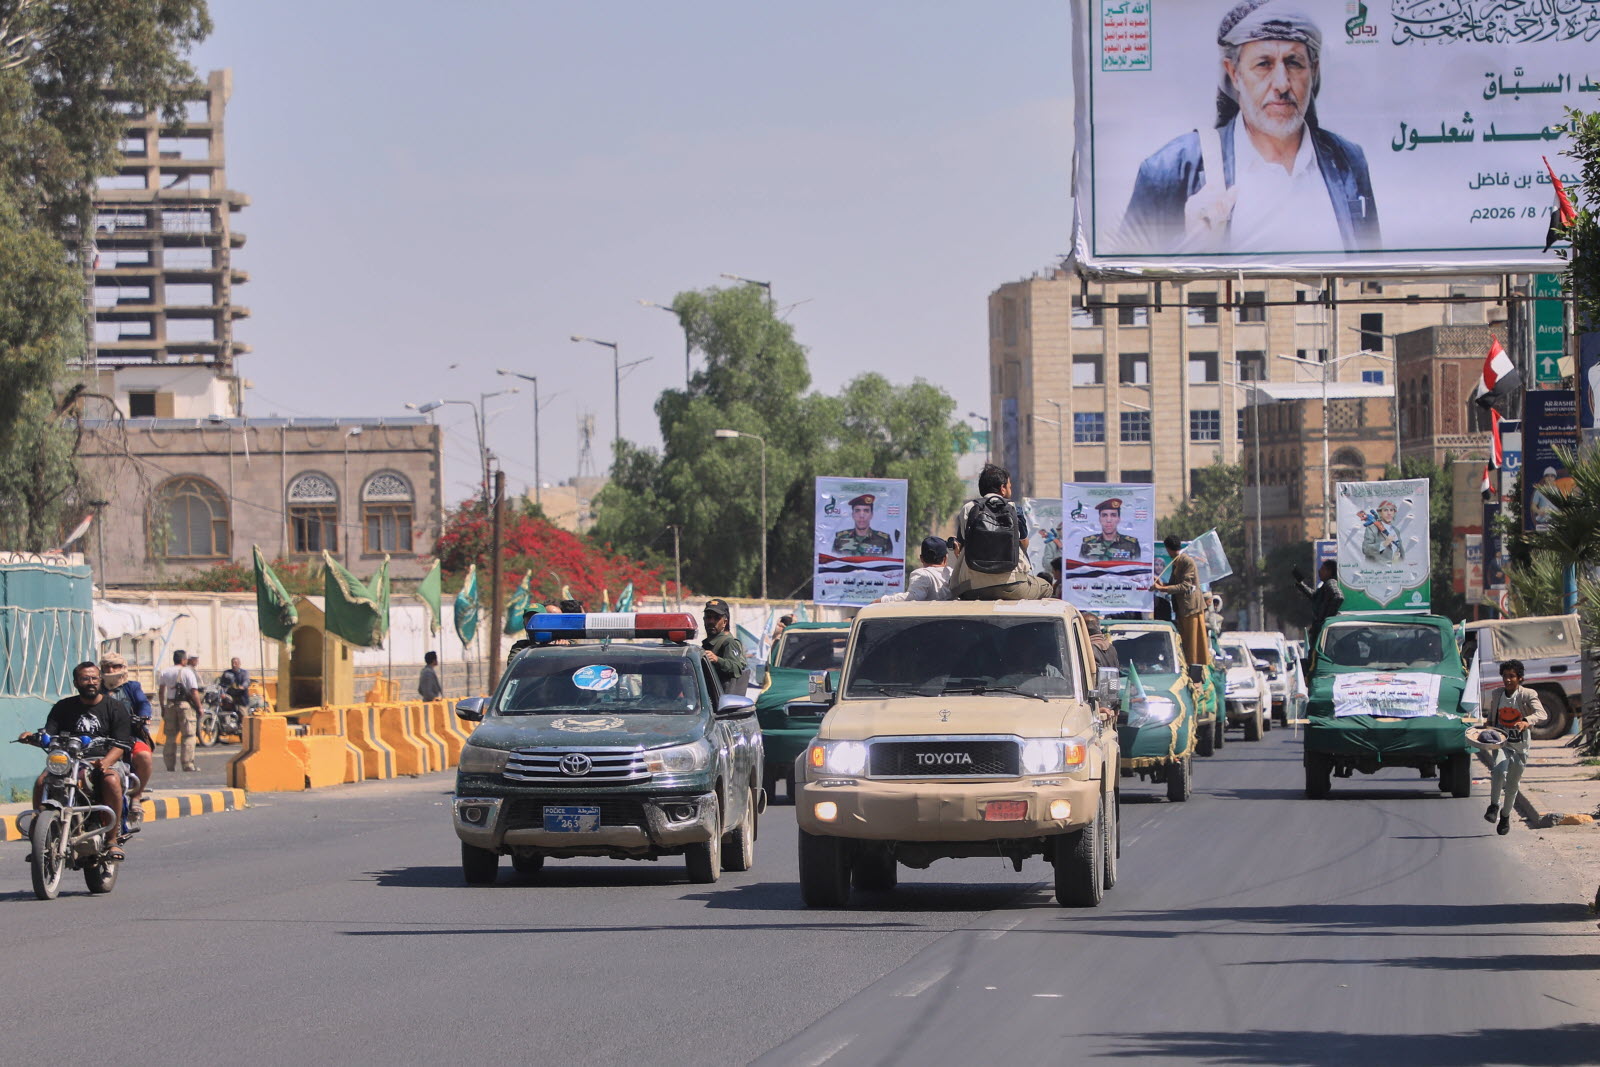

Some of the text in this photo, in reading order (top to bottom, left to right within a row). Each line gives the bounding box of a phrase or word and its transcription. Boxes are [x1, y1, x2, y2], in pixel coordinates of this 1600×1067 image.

[1391, 111, 1475, 152] شعلول
[1469, 171, 1510, 190] فاضل
[1514, 173, 1532, 189] بن
[1538, 325, 1564, 335] Airpo
[916, 753, 972, 764] TOYOTA
